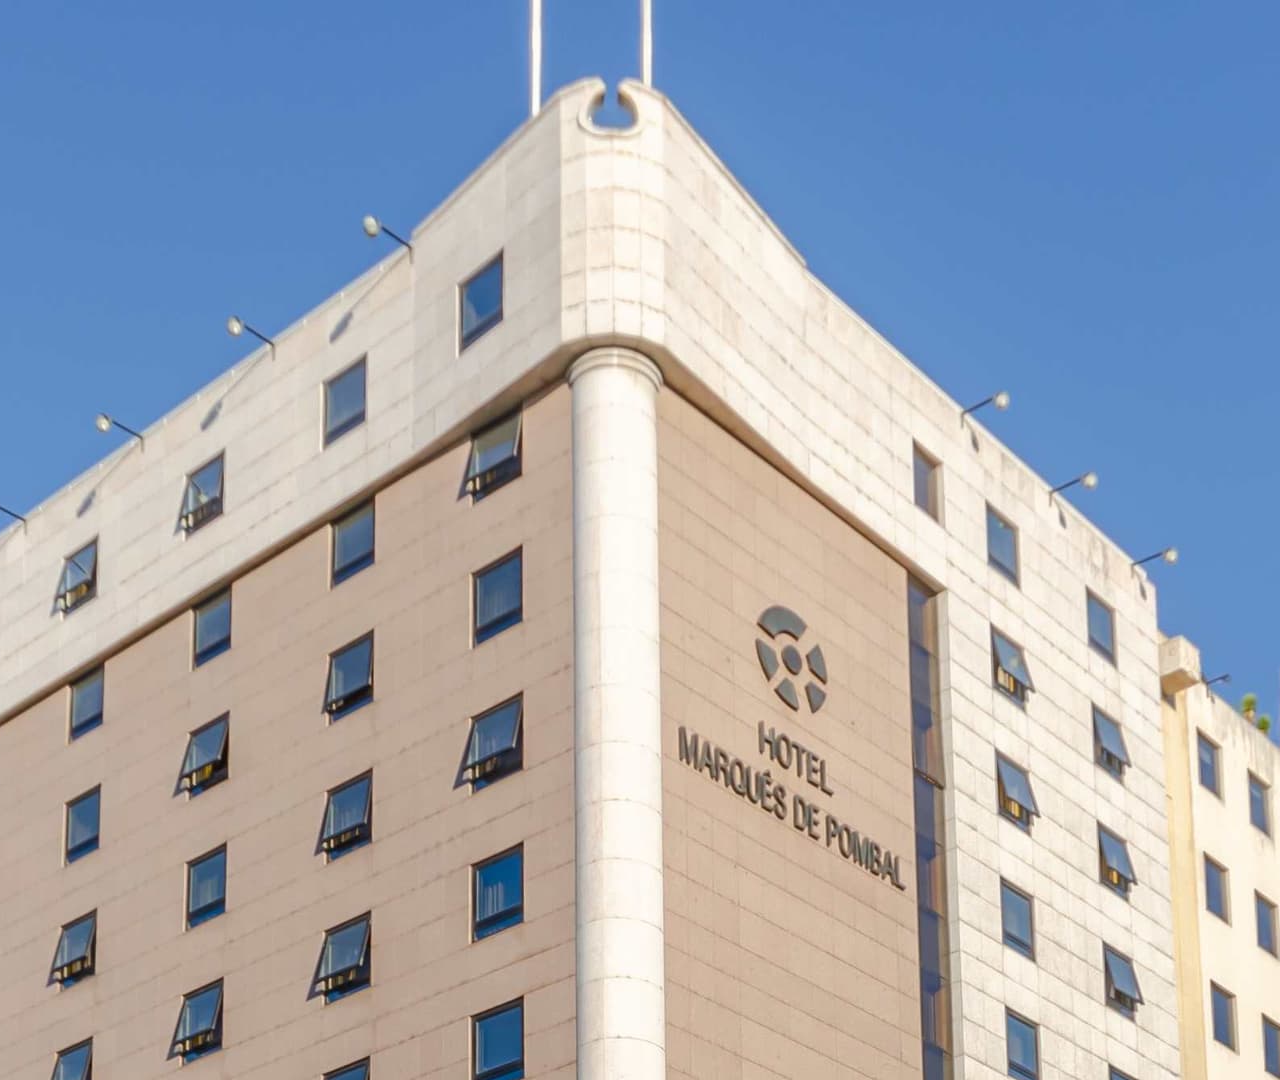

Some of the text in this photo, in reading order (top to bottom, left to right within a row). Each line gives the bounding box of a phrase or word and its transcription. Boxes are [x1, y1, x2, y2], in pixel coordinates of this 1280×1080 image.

[678, 725, 906, 891] MARQUÊS DE POMBAL
[758, 720, 834, 797] HOTEL
